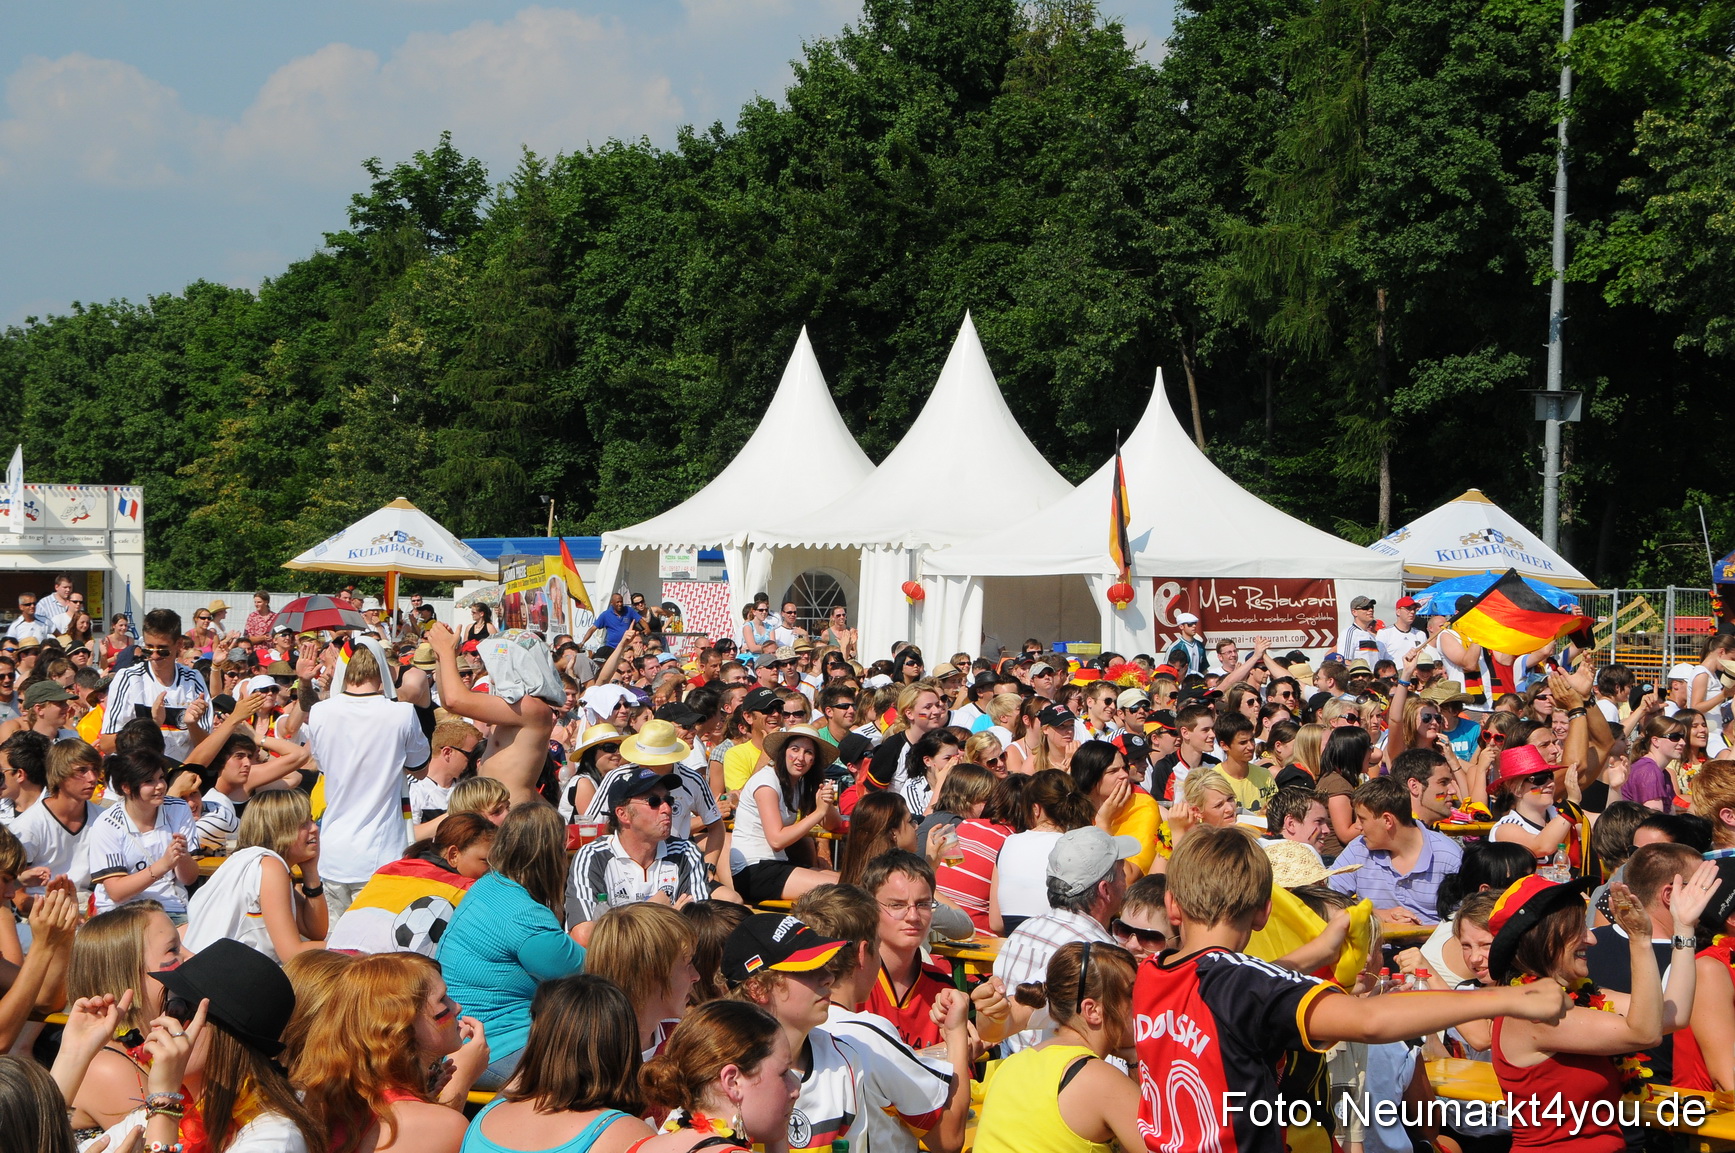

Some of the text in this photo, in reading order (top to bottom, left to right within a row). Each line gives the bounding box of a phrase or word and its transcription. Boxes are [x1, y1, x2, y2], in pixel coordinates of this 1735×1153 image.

[347, 543, 443, 564] KULMBACHER
[1435, 543, 1554, 571] KULMBACHER
[1199, 579, 1336, 613] Mai Restaurant
[1133, 1009, 1211, 1060] DOLSKI
